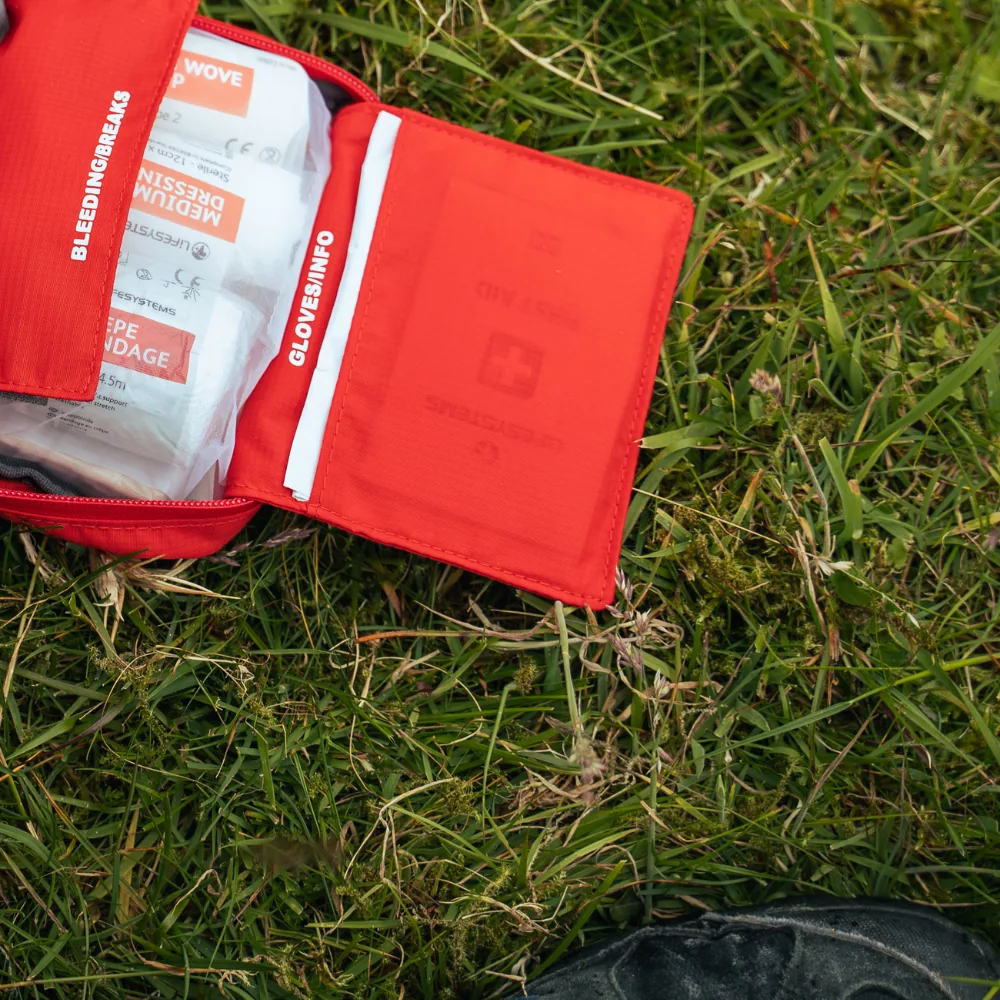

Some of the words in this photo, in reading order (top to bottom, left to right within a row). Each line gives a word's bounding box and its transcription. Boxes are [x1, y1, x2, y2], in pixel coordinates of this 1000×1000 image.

[183, 57, 243, 88] WOVE
[157, 148, 186, 166] 12cm
[70, 90, 131, 262] BLEEDING/BREAKS
[197, 163, 230, 183] Sterile
[132, 182, 222, 227] MEDIUM
[138, 167, 225, 211] DRESSIN
[124, 220, 191, 251] LIFESYSTE
[112, 289, 177, 316] FESYSTEMS
[288, 230, 335, 367] GLOVES/INFO
[106, 316, 140, 340] EPE
[104, 336, 171, 369] NDAGE
